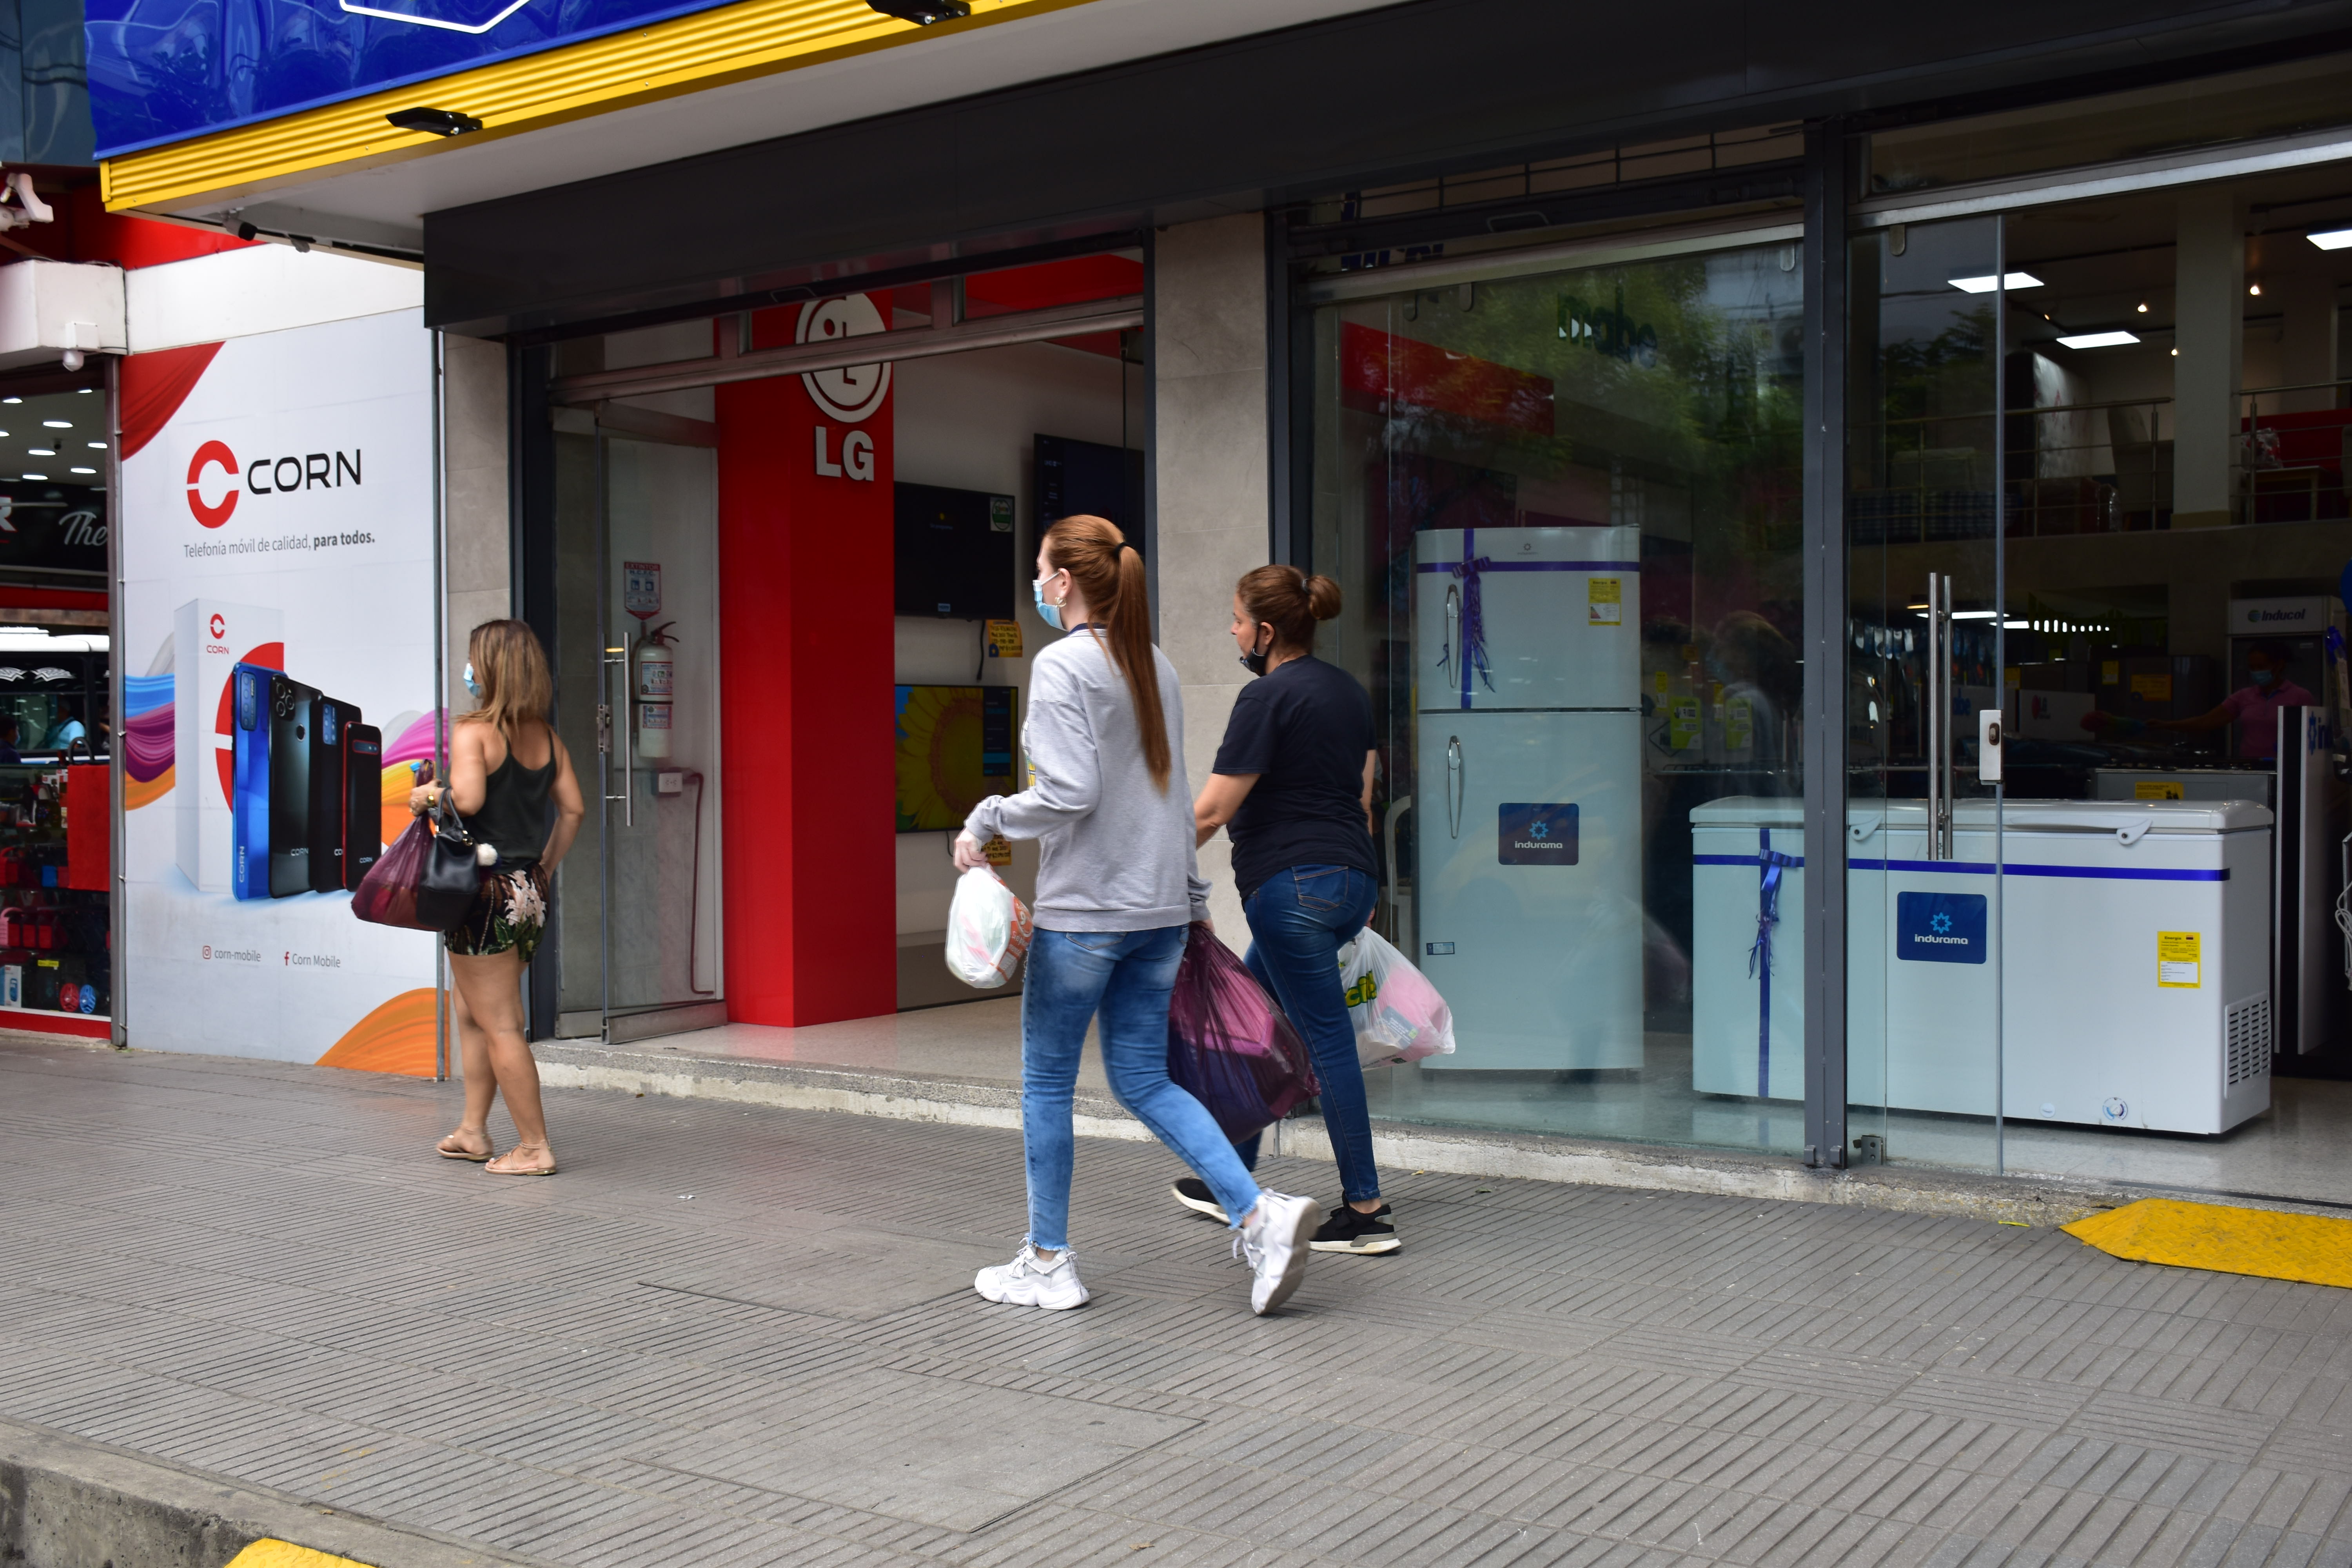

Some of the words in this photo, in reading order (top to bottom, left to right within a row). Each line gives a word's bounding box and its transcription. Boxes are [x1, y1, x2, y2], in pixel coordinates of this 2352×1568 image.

[1557, 287, 1657, 369] mabe
[815, 425, 874, 481] LG
[248, 449, 361, 495] CORN
[58, 511, 107, 546] The
[183, 540, 227, 558] Telefonía
[229, 537, 256, 555] móvil
[258, 537, 271, 552] de
[272, 534, 311, 551] calidad,
[313, 535, 338, 550] para
[340, 530, 376, 545] todos.
[2261, 609, 2306, 621] Inducol
[207, 645, 229, 655] CORN
[1515, 840, 1563, 849] indurama
[290, 848, 309, 857] CORN
[1914, 934, 1968, 945] indurama
[214, 949, 261, 962] corn-mobile
[292, 953, 311, 966] Corn
[313, 955, 341, 968] Mobile
